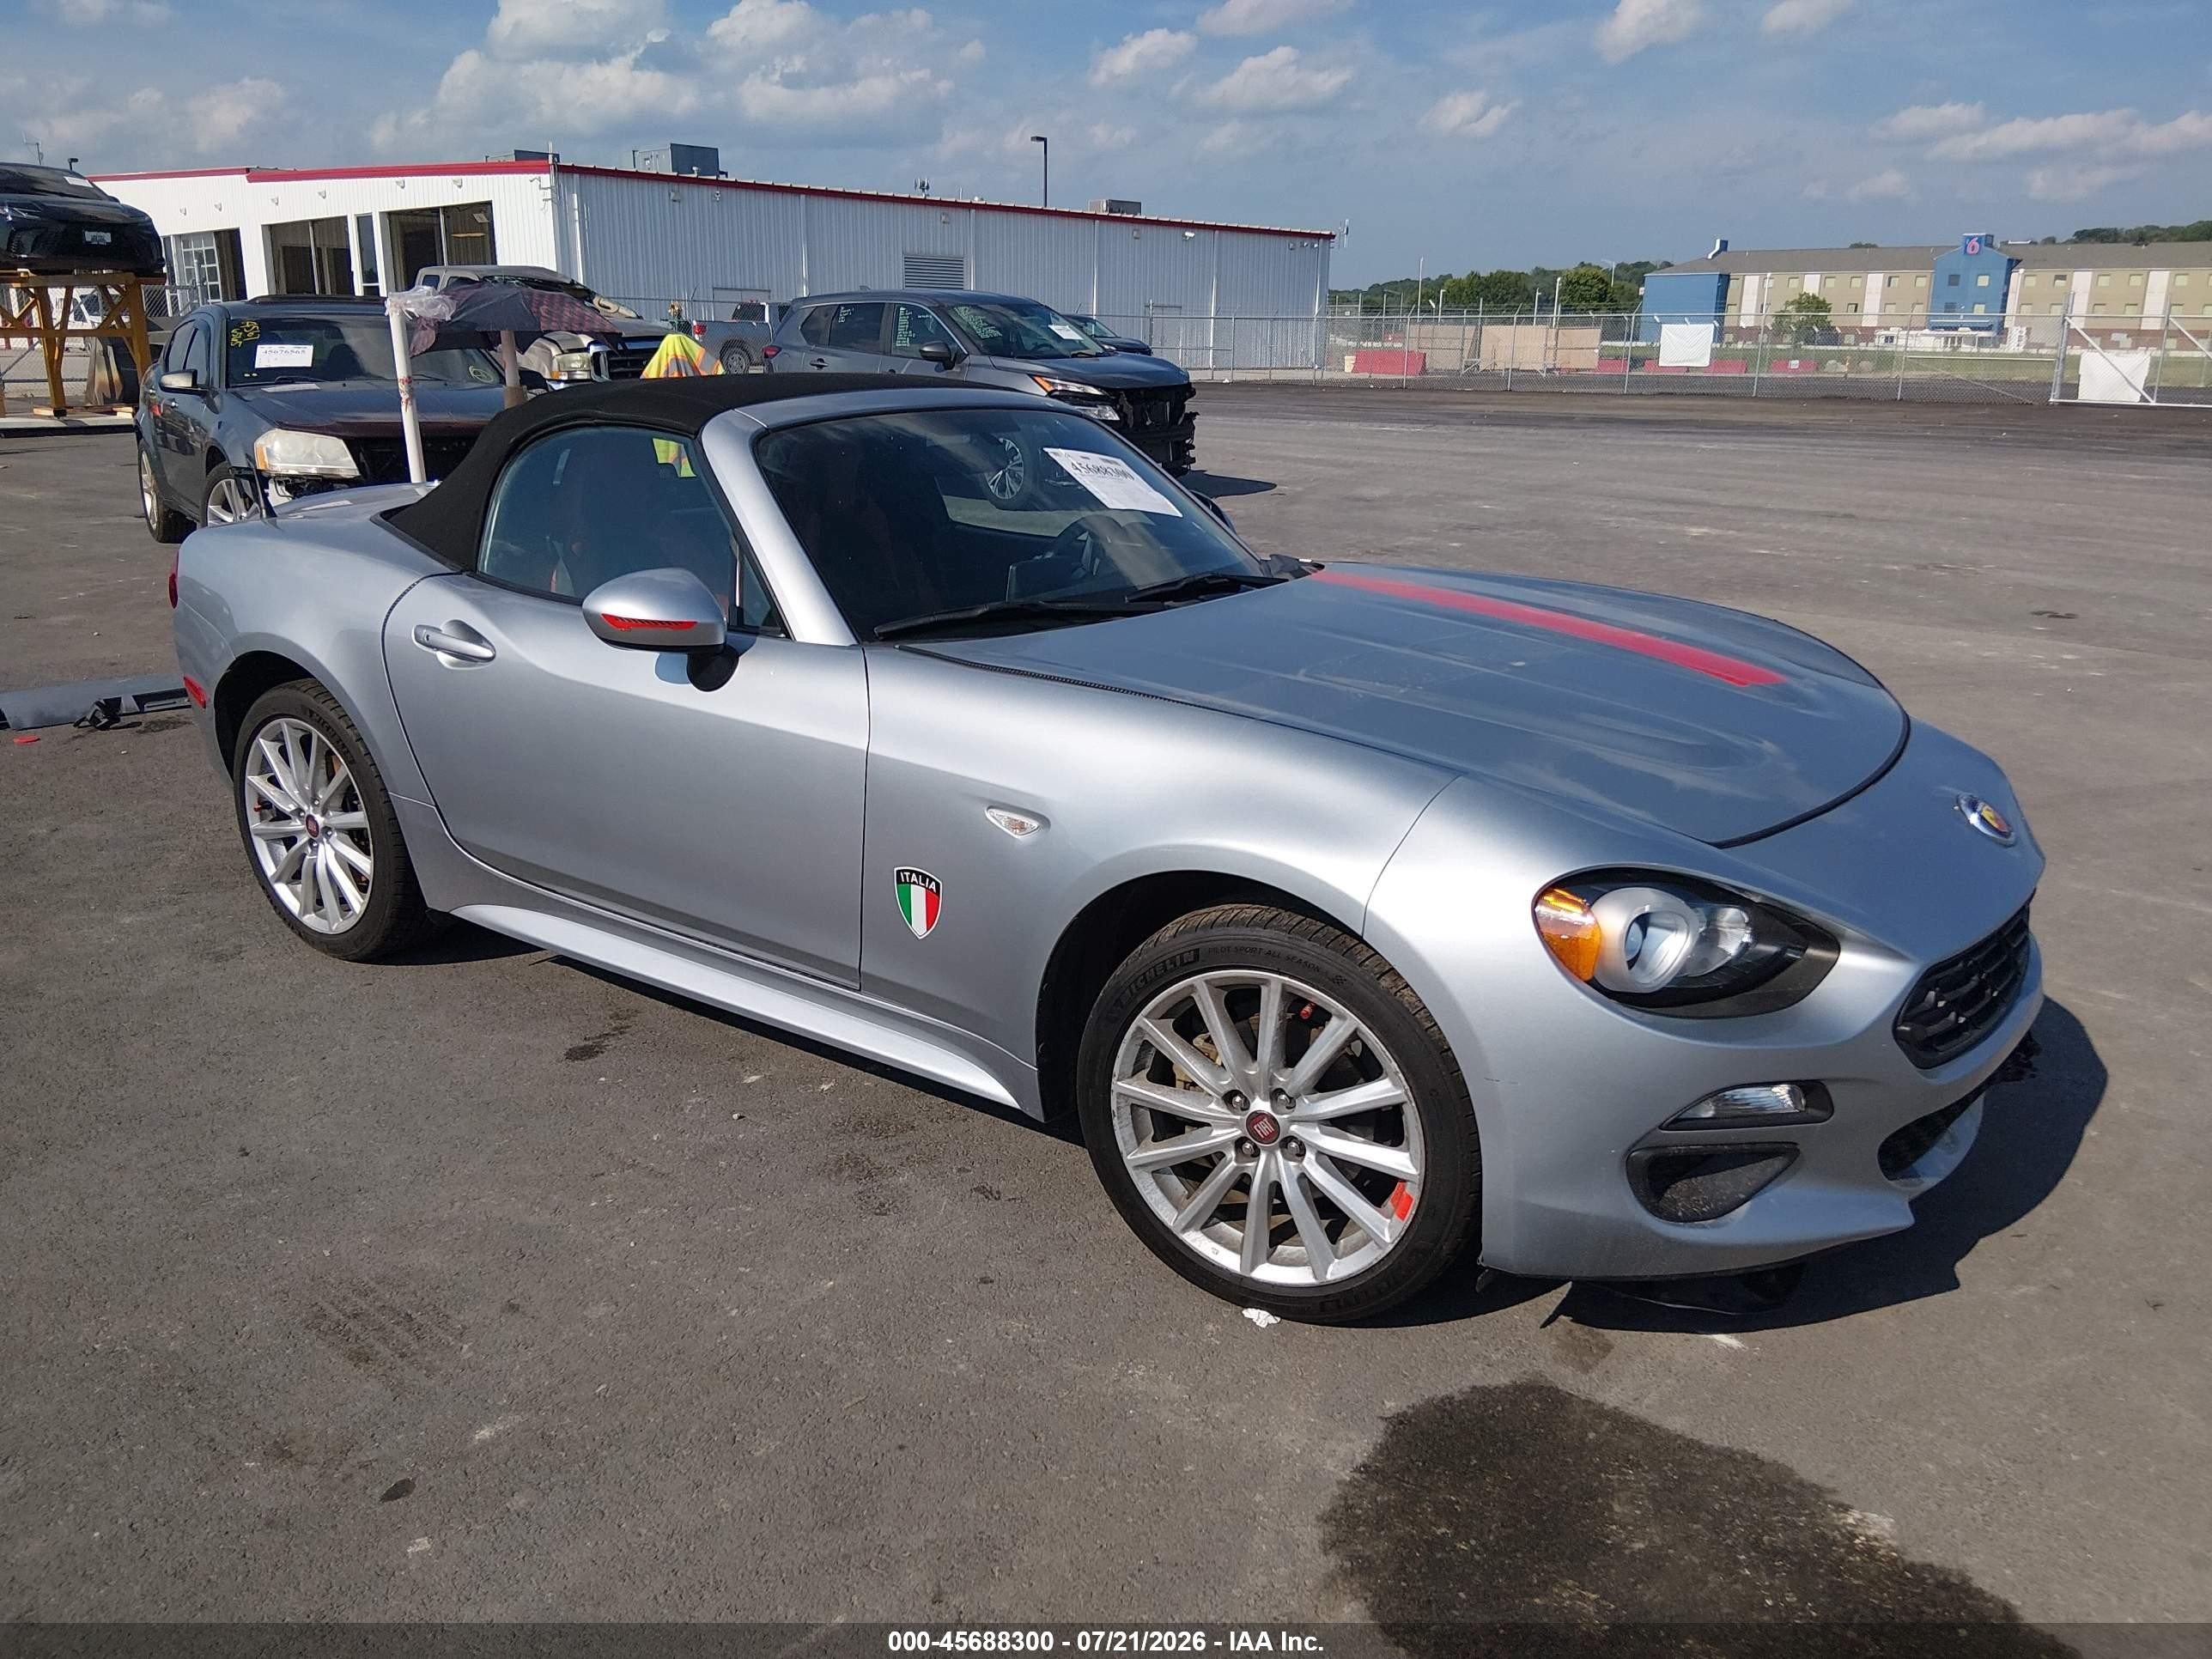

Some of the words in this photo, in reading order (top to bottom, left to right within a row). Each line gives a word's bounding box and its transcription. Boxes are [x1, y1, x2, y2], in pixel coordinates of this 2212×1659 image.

[1966, 236, 1979, 254] 6
[900, 872, 937, 893] ITALIA
[1118, 950, 1197, 1006] MICHELIN
[1208, 946, 1231, 955] PILOT
[1233, 945, 1263, 955] SPORT
[1265, 949, 1281, 958] ALL
[1284, 953, 1322, 973] SEASON
[1254, 1117, 1275, 1139] FIAT
